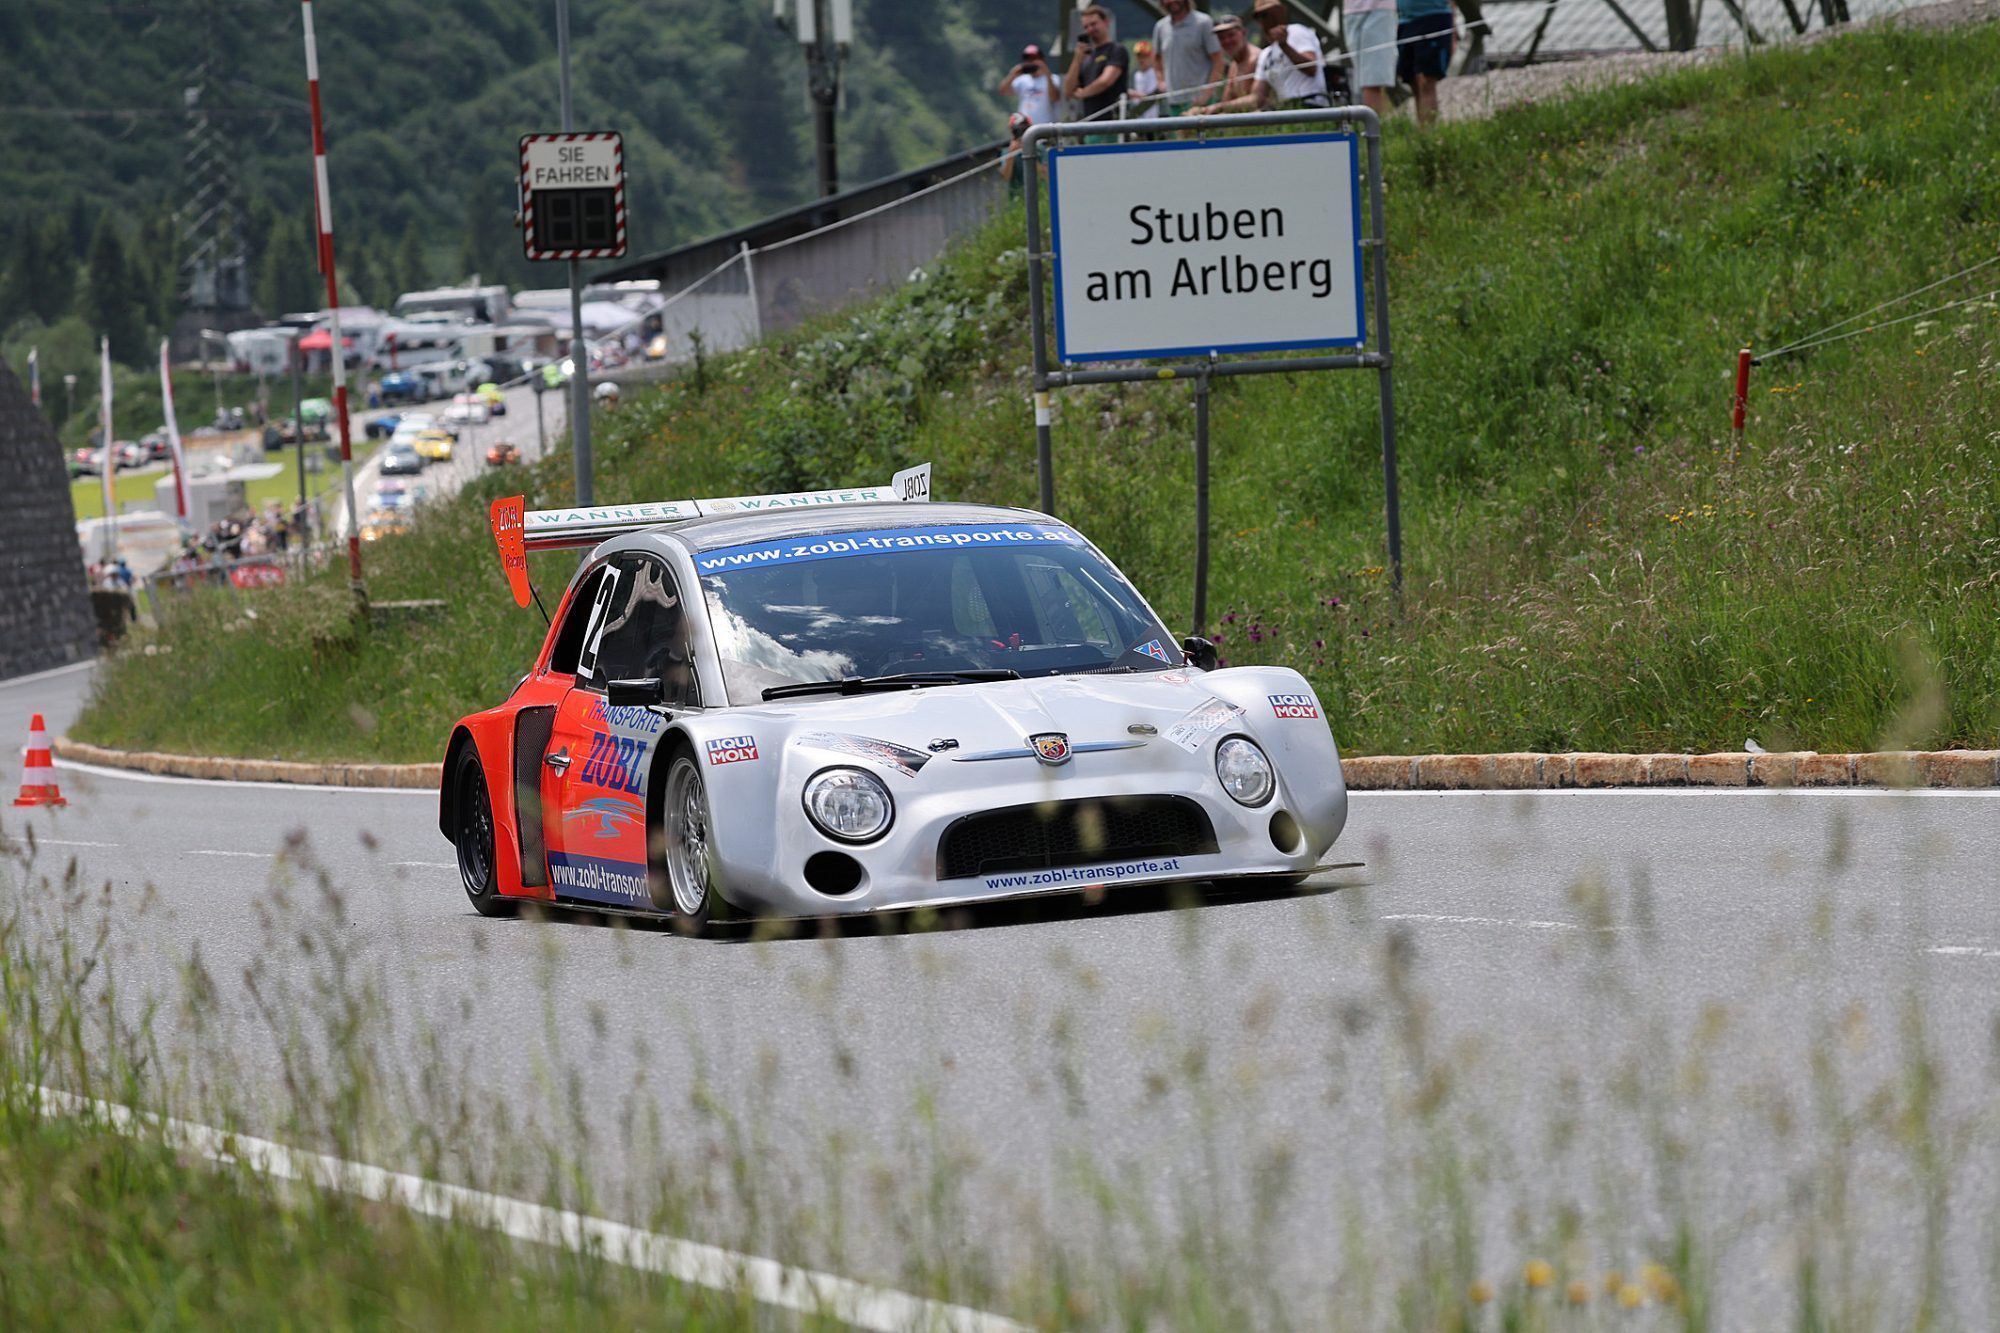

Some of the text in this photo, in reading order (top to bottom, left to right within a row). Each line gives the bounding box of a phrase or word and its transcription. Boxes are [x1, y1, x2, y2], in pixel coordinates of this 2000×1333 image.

[558, 146, 584, 163] SIE
[535, 165, 609, 184] FAHREN
[1129, 202, 1284, 245] Stuben
[1086, 254, 1332, 302] am Arlberg
[740, 491, 879, 509] WANNER
[538, 506, 681, 523] WANNER
[700, 528, 1074, 570] www.zobl-transporte.at
[580, 573, 616, 671] 2
[1268, 695, 1313, 706] LIQUI
[588, 700, 661, 733] TRANSPORTE
[1275, 706, 1318, 718] MOLY
[707, 736, 755, 751] LIQUI
[581, 732, 647, 796] ZOBL
[711, 748, 757, 765] MOLY
[986, 858, 1180, 889] www.zobl-transporte.at
